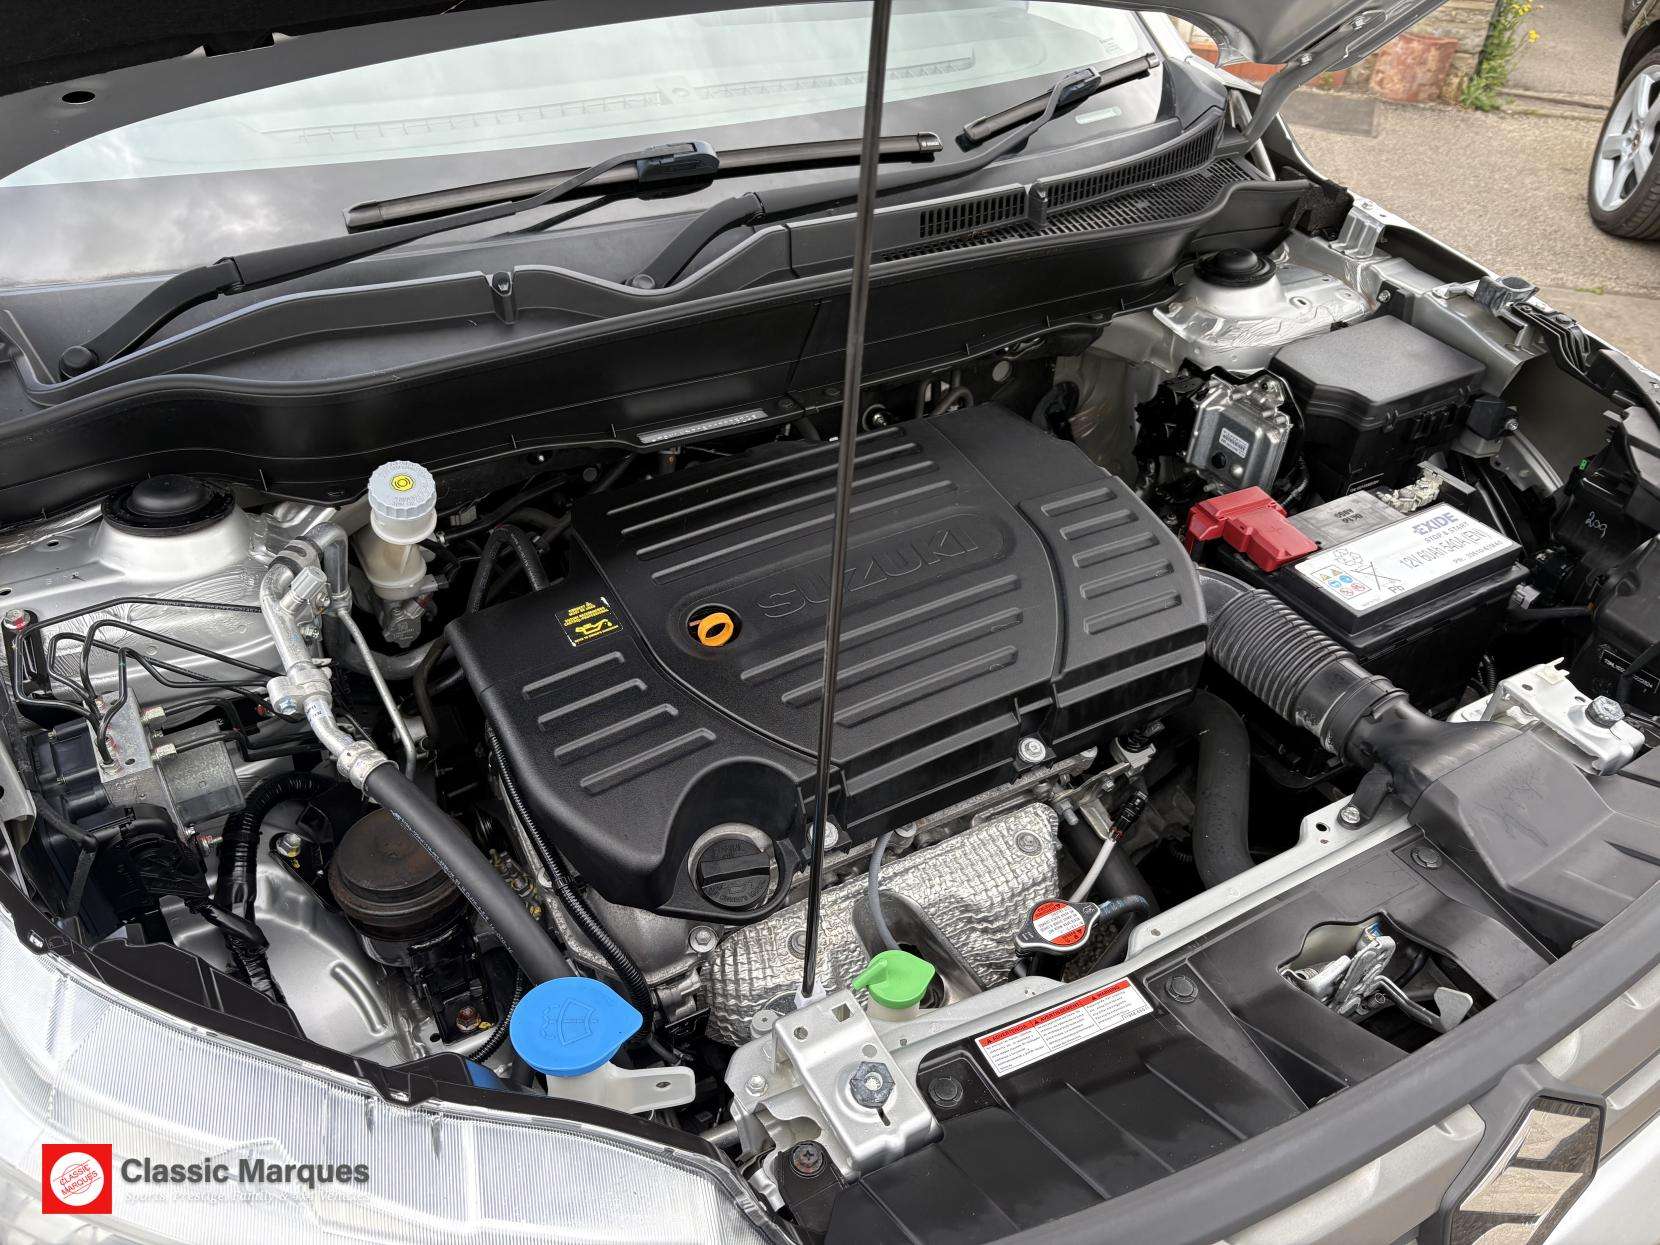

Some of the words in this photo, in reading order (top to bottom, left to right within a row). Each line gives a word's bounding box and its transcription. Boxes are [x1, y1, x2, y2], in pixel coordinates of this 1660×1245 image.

[1411, 512, 1459, 535] EXIDE
[1424, 531, 1442, 544] STOP
[1399, 553, 1422, 569] 12V
[757, 528, 979, 618] SUZUKI
[1387, 584, 1404, 595] Pb
